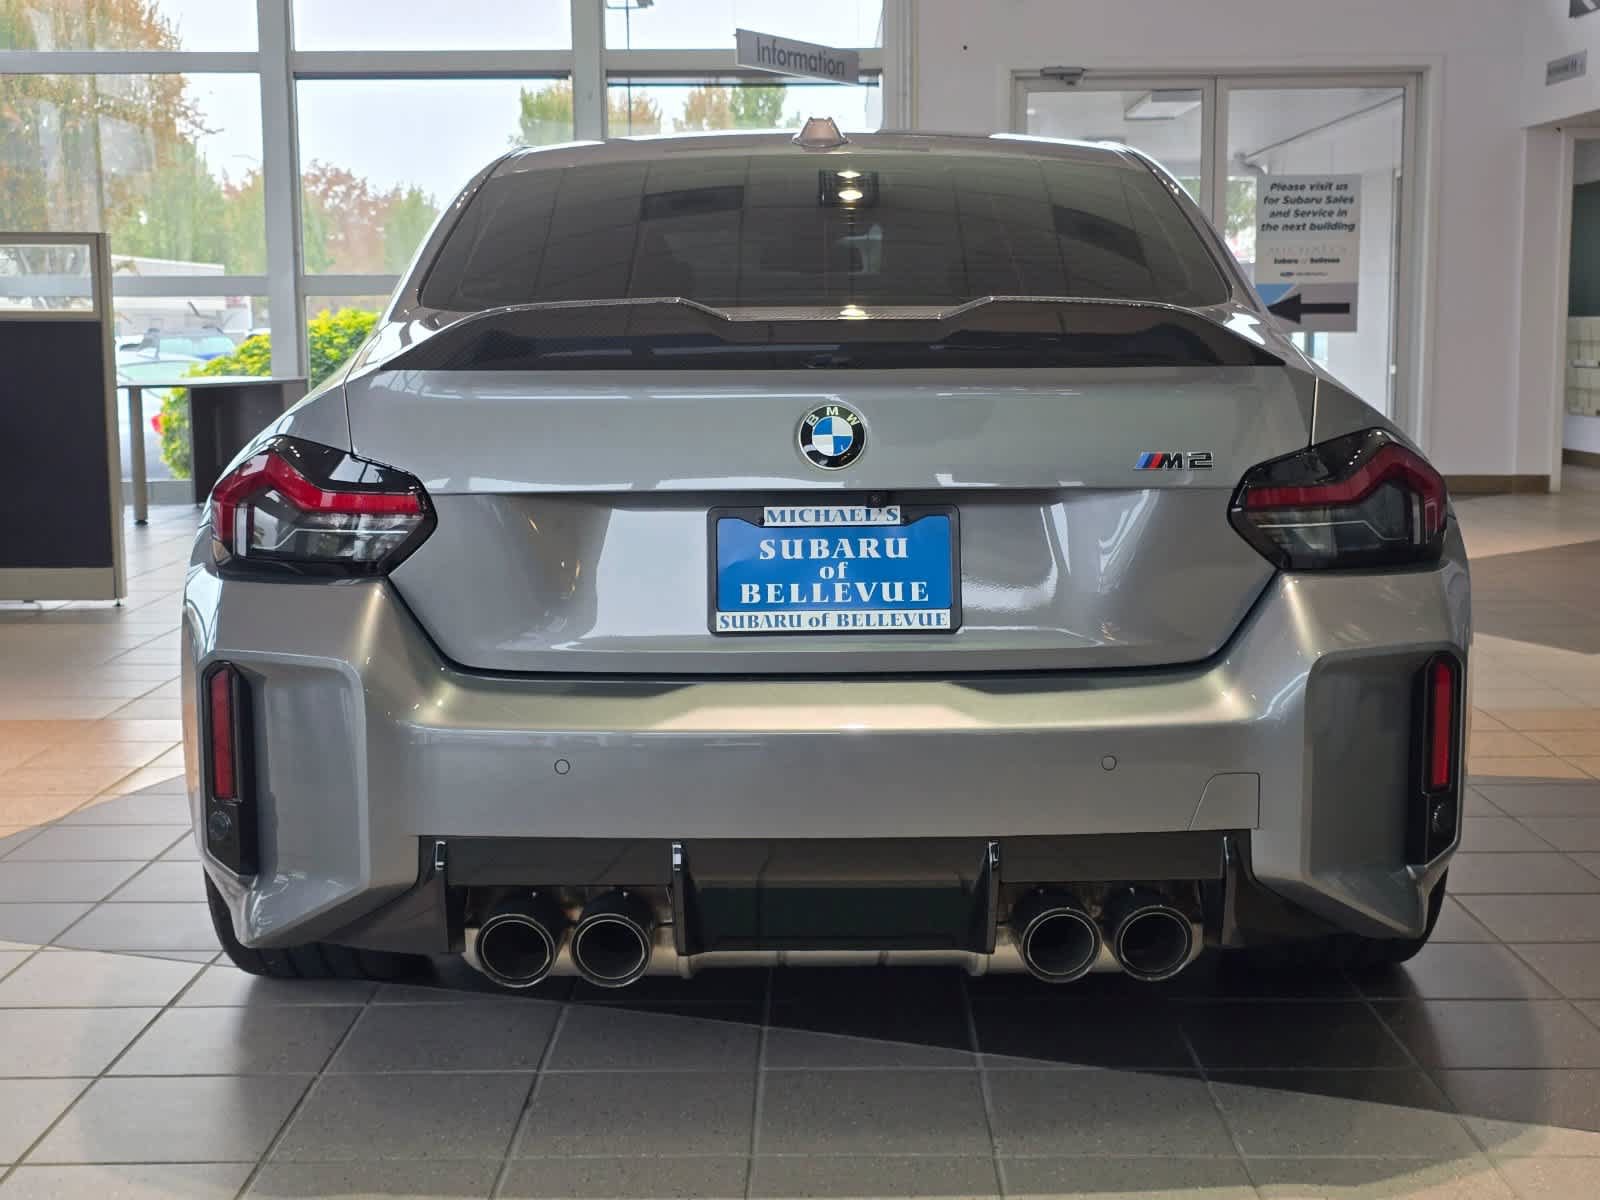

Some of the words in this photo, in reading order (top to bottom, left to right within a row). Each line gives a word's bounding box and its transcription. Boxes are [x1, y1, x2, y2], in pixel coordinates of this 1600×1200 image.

[757, 37, 845, 77] Information
[1270, 182, 1306, 191] Please
[1309, 182, 1333, 191] visit
[1336, 183, 1348, 191] us
[1263, 195, 1280, 205] for
[1282, 195, 1322, 205] Subaru
[1325, 195, 1354, 205] Sales
[1269, 208, 1291, 218] and
[1293, 208, 1335, 218] Service
[1337, 208, 1348, 217] in
[1261, 222, 1279, 232] the
[1281, 223, 1307, 231] next
[1309, 222, 1356, 232] building
[806, 406, 860, 426] BMW
[765, 507, 899, 523] MICHAEL'S
[759, 537, 909, 560] SUBARU
[819, 561, 849, 580] of
[740, 581, 929, 604] BELLEVUE
[719, 613, 802, 629] SUBARU
[808, 612, 829, 628] of
[837, 612, 948, 628] BELLEVUE
